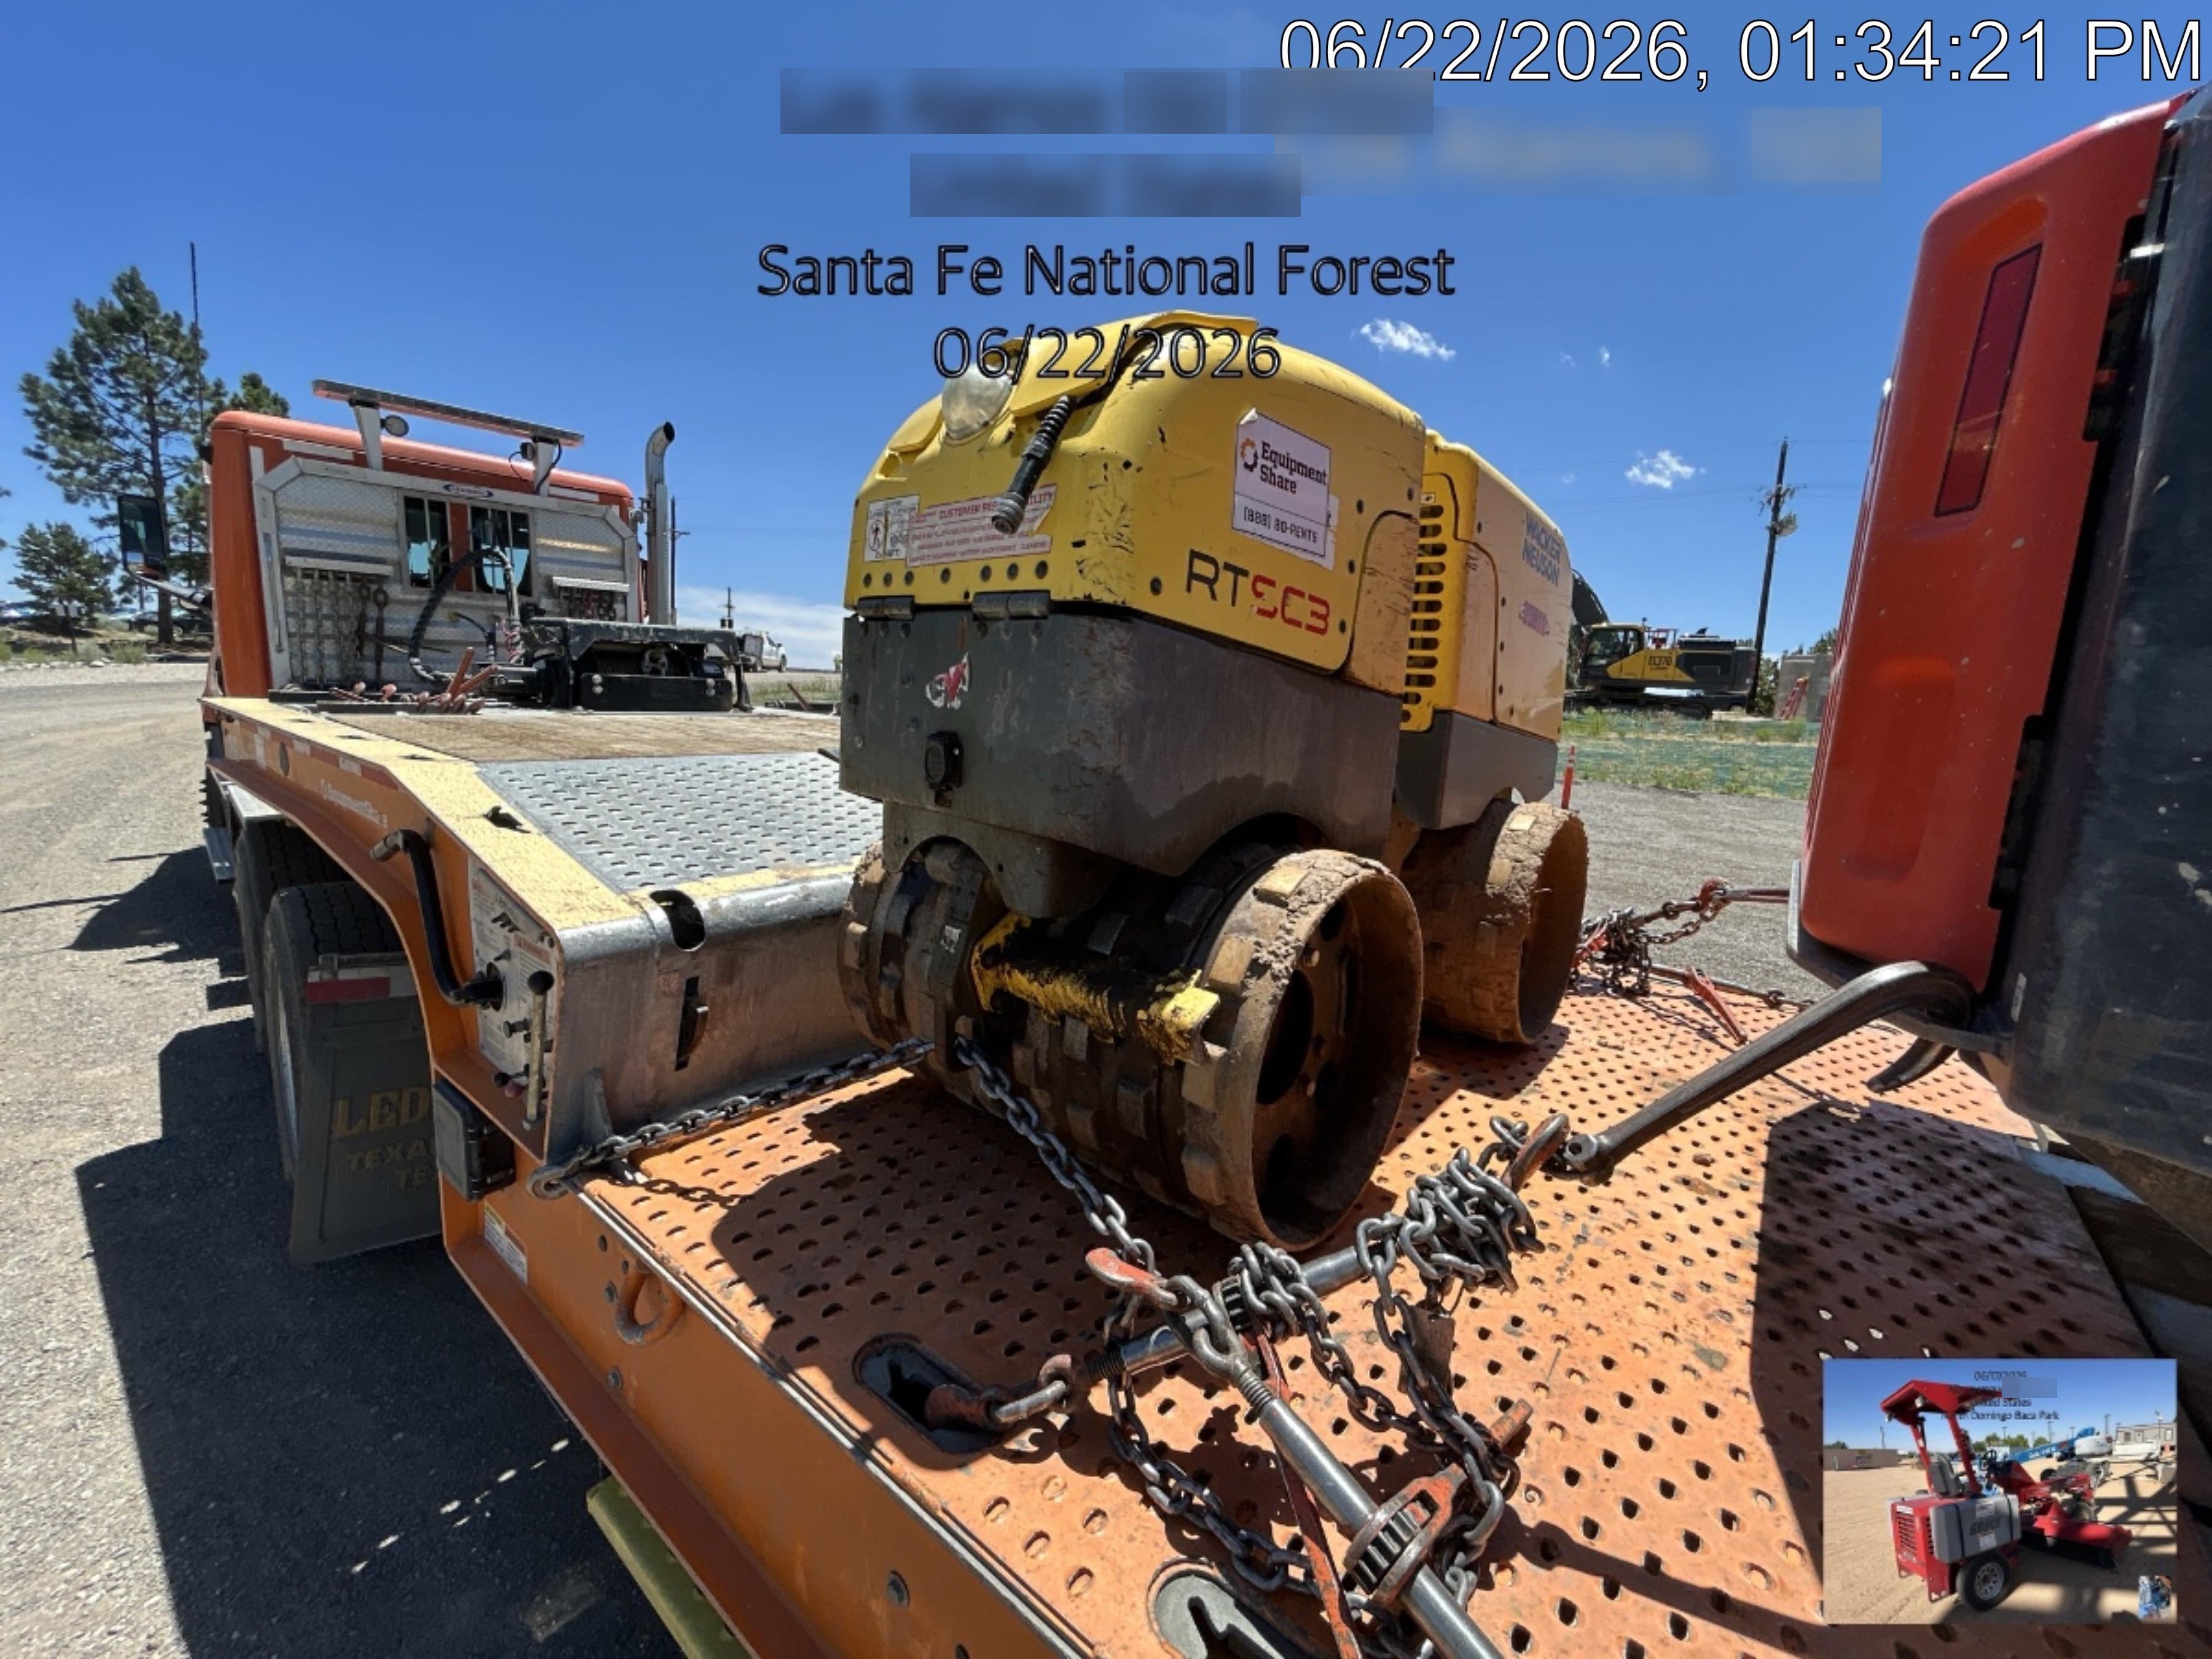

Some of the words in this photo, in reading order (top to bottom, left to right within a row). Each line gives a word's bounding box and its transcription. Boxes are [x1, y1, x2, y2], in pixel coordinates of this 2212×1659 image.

[1260, 464, 1297, 494] Share
[1261, 440, 1328, 485] Equipment
[939, 504, 980, 520] CUSTOMER
[1185, 549, 1330, 636] RTSC3
